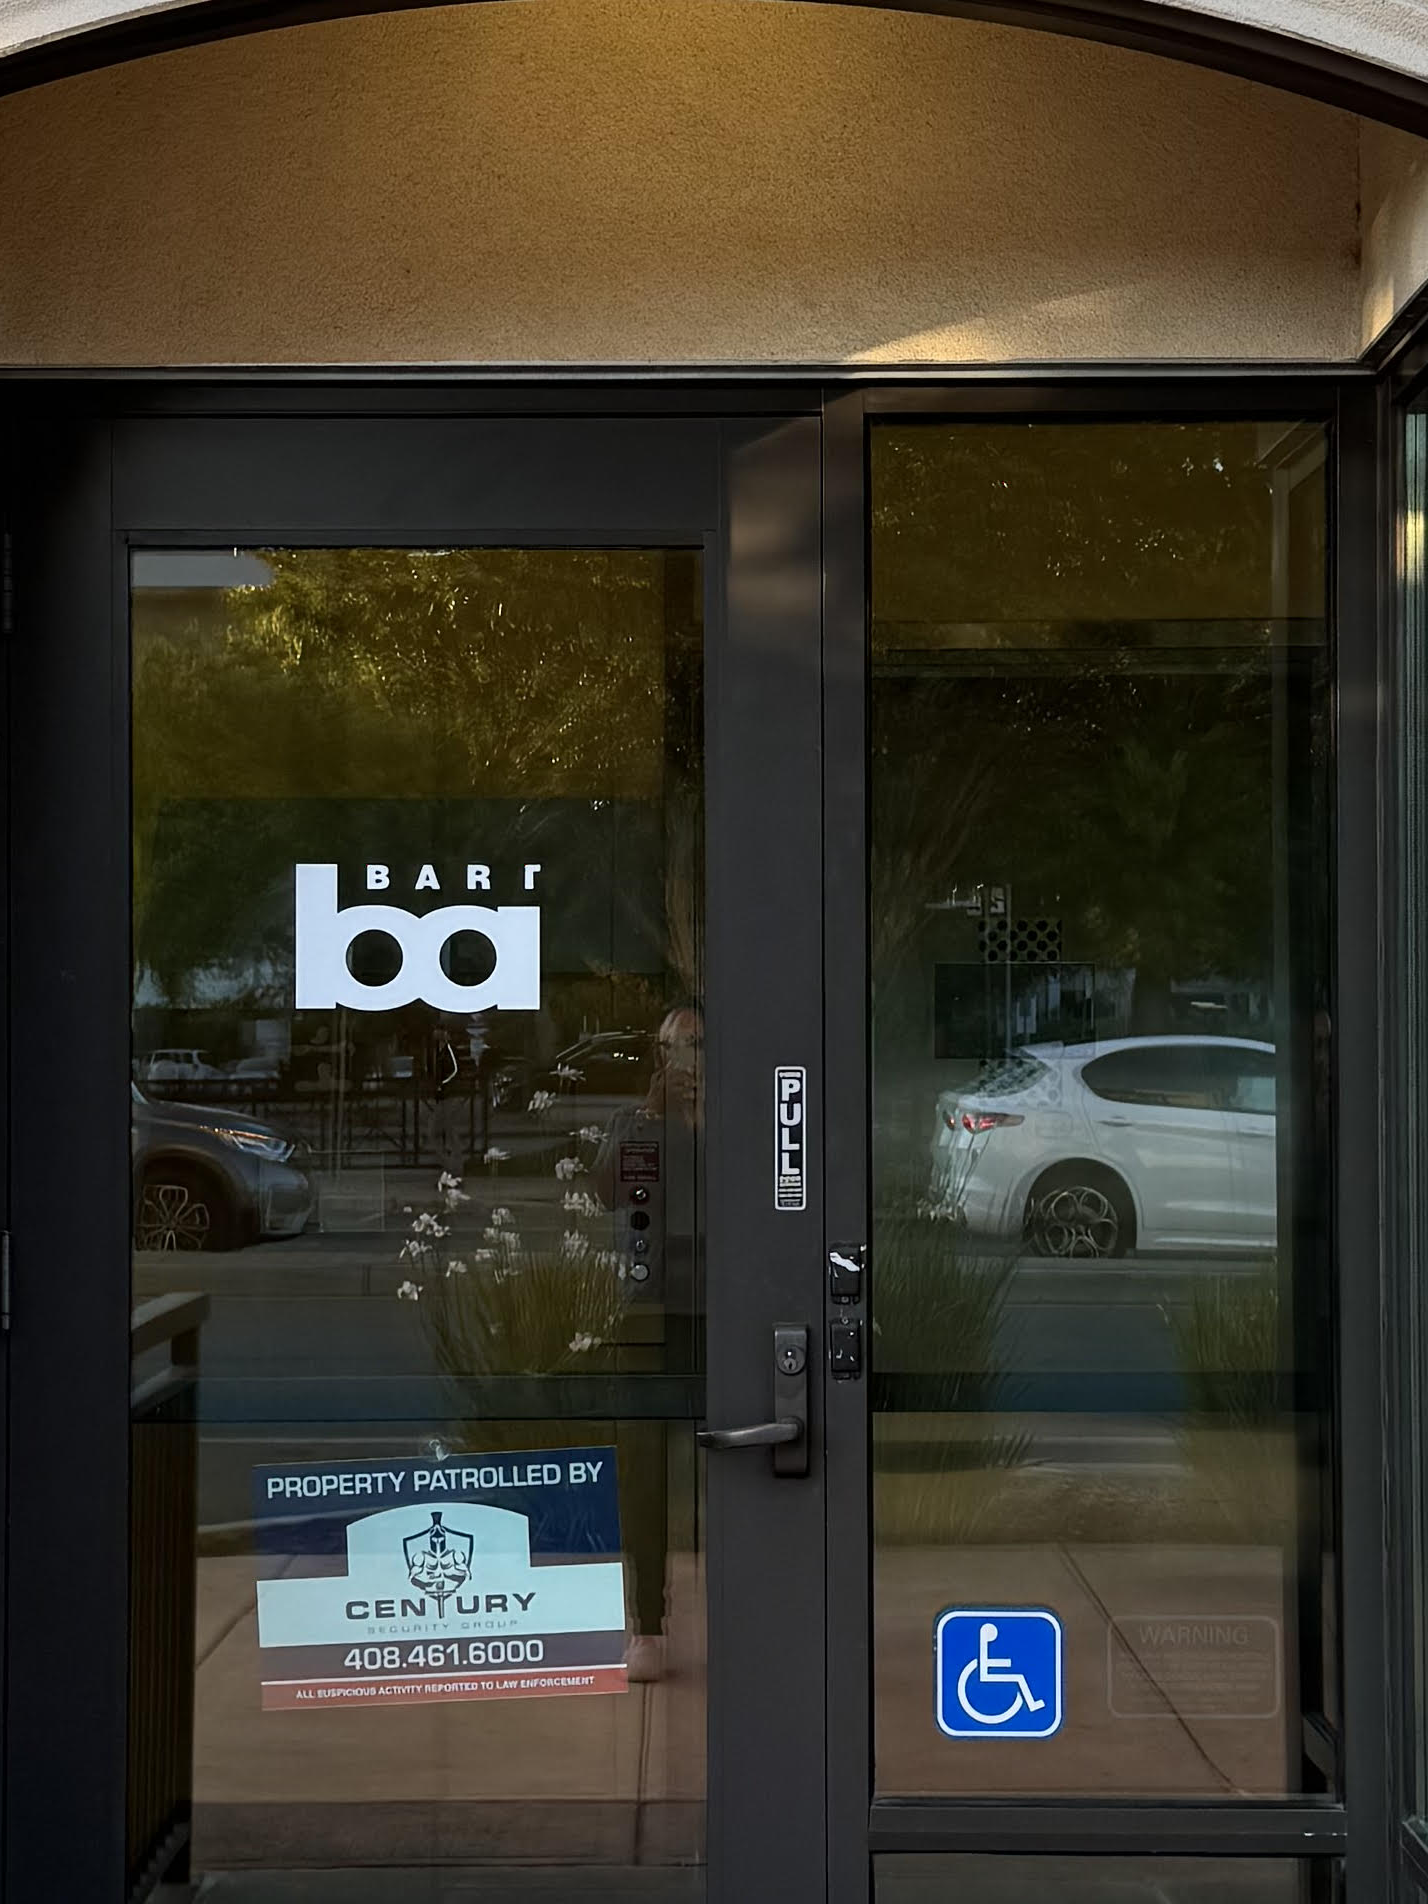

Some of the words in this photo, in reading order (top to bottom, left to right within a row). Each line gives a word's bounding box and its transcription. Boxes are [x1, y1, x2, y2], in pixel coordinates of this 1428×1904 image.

[779, 1078, 802, 1176] PULL
[267, 1471, 406, 1499] PROPERTY
[413, 1463, 562, 1492] PATROLLED
[568, 1461, 604, 1484] BY
[345, 1592, 537, 1621] CENTURY
[367, 1622, 450, 1635] SECURITY
[460, 1619, 520, 1630] GROUP
[1139, 1625, 1250, 1646] WARNING
[344, 1639, 545, 1671] 408.461.6000
[296, 1689, 316, 1699] ALL
[317, 1686, 377, 1699] SUSPICIOUS
[378, 1684, 423, 1696] ACTIVITY
[424, 1681, 478, 1694] REPORTED
[480, 1680, 494, 1691] TO
[495, 1679, 519, 1690] LAW
[520, 1676, 596, 1689] ENFORCEMENT
